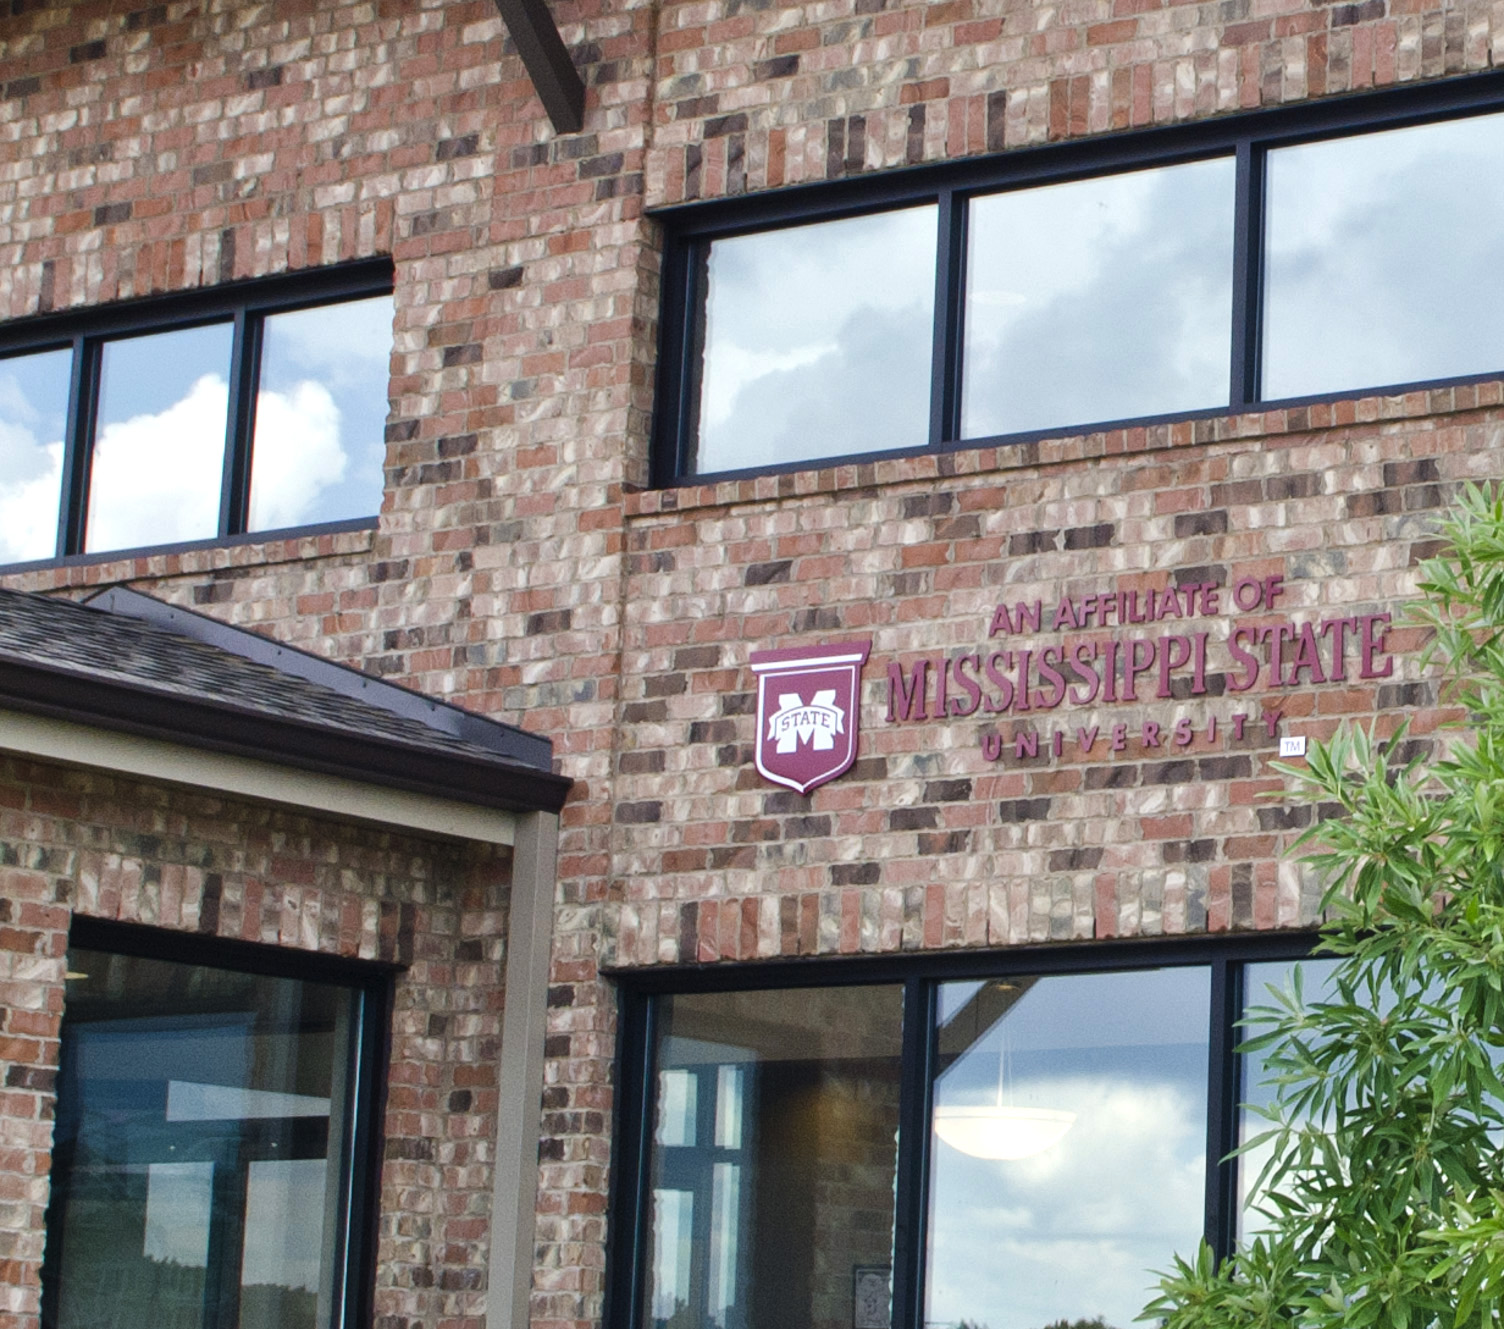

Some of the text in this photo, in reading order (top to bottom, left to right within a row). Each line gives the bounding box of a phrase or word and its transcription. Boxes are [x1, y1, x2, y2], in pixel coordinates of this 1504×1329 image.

[989, 576, 1284, 638] AN AFFILIATE OF
[885, 612, 1394, 723] MISSISSIPPI STATE
[780, 710, 832, 732] STATE
[981, 710, 1283, 762] UNIVERSITY
[1284, 740, 1302, 753] TM
